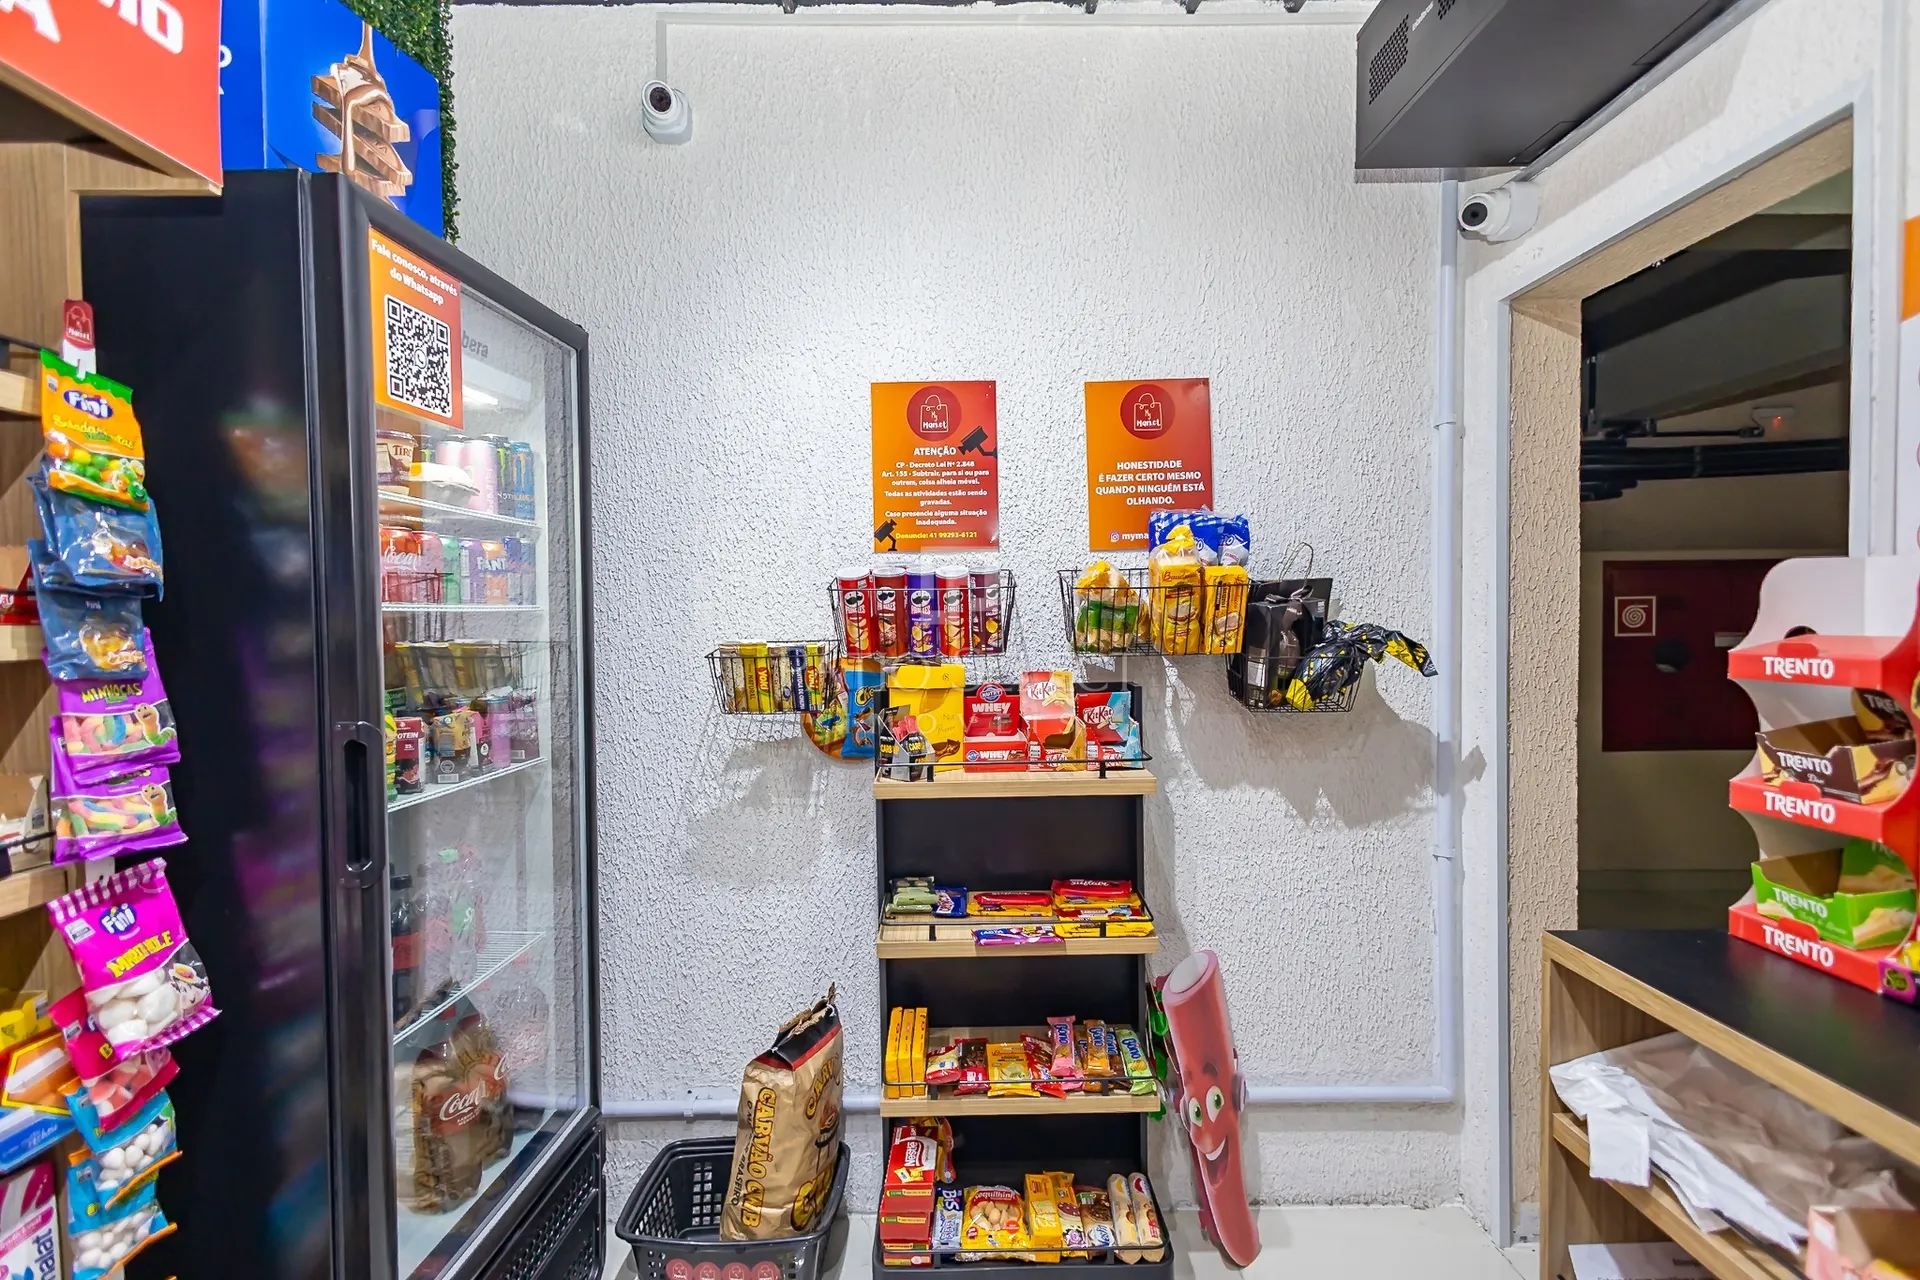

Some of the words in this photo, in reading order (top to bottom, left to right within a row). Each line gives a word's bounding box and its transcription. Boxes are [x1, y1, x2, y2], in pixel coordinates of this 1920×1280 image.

[371, 238, 391, 259] Fale
[392, 253, 429, 281] conosco,
[429, 274, 458, 296] através
[390, 267, 402, 281] do
[402, 273, 444, 305] Whatsapp
[68, 391, 109, 418] Fini
[913, 445, 957, 458] ATENÇÃO
[895, 461, 905, 469] CP
[909, 461, 935, 469] Decreto
[1116, 460, 1183, 470] HONESTIDADE
[958, 477, 980, 485] móvel.
[1098, 473, 1104, 482] É
[1105, 473, 1134, 482] FAZER
[1135, 472, 1165, 481] CERTO
[1166, 471, 1201, 480] MESMO
[1095, 485, 1136, 495] QUANDO
[1137, 483, 1181, 493] NINGUÉM
[1182, 481, 1205, 492] ESTÁ
[920, 499, 952, 507] gravadas.
[1126, 496, 1175, 505] OLHANDO.
[902, 510, 933, 519] presencie
[934, 510, 959, 518] alguma
[960, 509, 988, 518] situação
[915, 518, 957, 527] inadequada.
[895, 532, 929, 540] Denuncie:
[938, 531, 977, 539] 99293-6121
[1762, 656, 1835, 680] TRENTO
[757, 669, 769, 690] YOKI
[971, 702, 1011, 715] WHEY
[979, 750, 1010, 761] WHEY
[1776, 751, 1833, 775] TRENTO
[1763, 791, 1836, 824] TRENTO
[1772, 887, 1828, 918] TRENTO
[101, 903, 136, 934] Fini
[1762, 925, 1834, 967] TRENTO
[747, 1087, 777, 1179] CARVÃO
